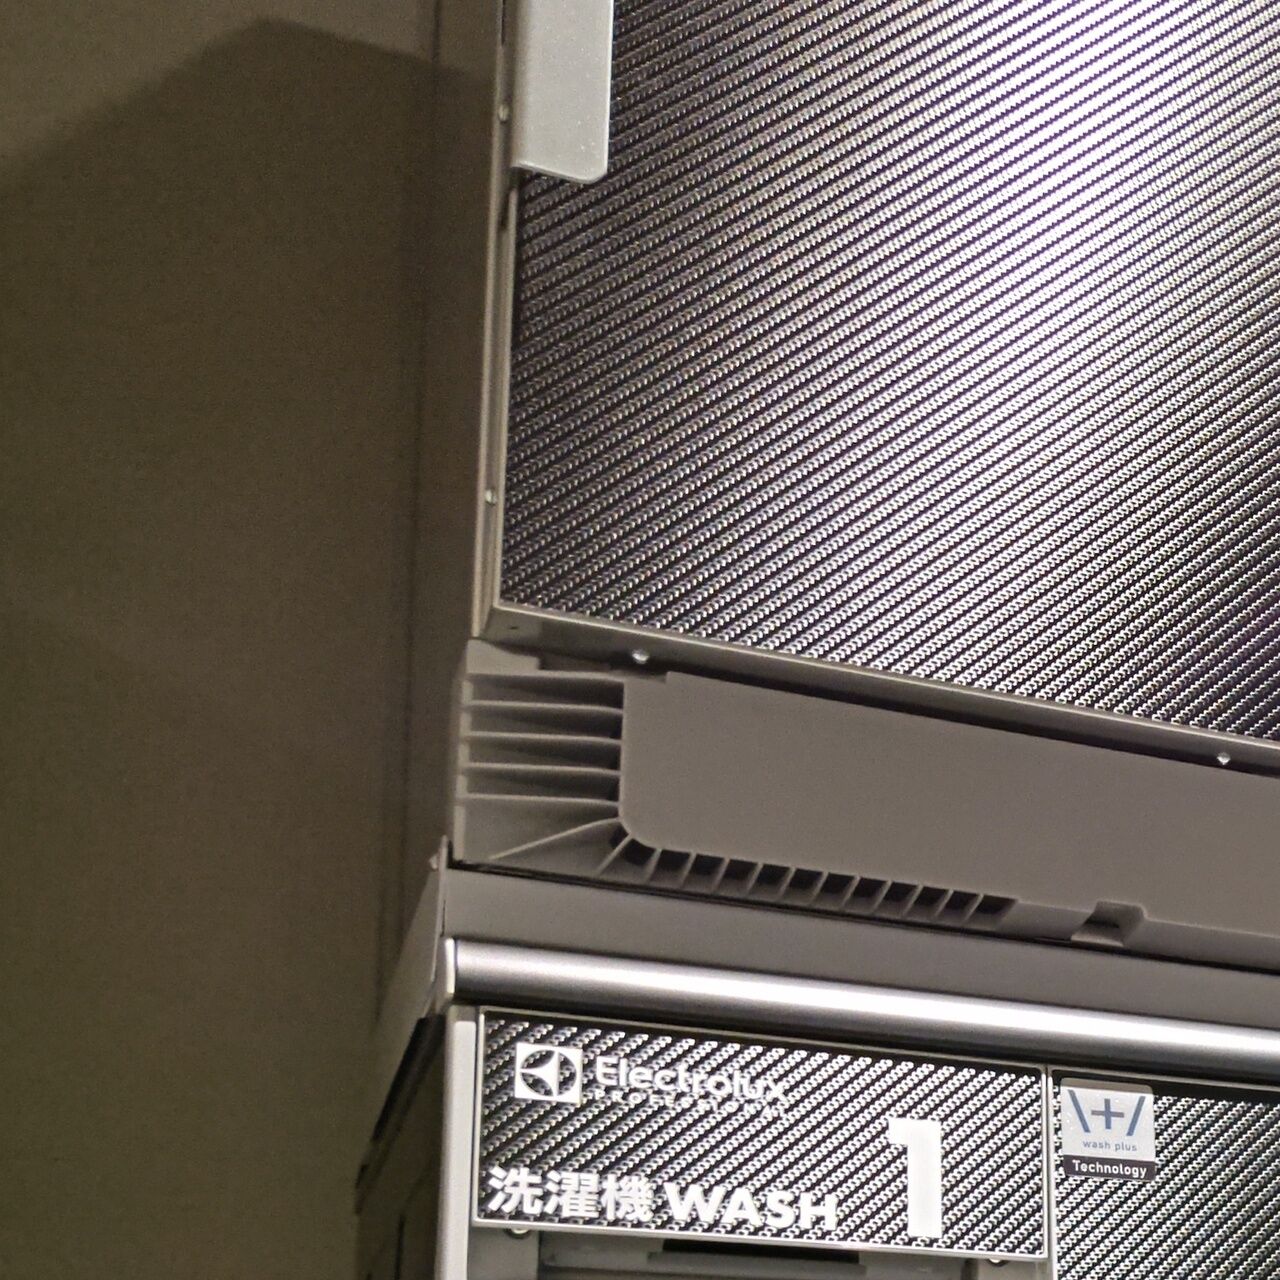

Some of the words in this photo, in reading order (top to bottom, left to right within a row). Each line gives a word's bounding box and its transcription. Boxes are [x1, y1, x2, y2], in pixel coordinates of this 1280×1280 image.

[596, 1055, 786, 1101] Electrolux
[1082, 1139, 1111, 1150] wash
[1115, 1141, 1138, 1152] plus
[488, 1166, 654, 1221] 洗濯機
[664, 1182, 838, 1231] WASH
[888, 1117, 942, 1238] 1
[1072, 1159, 1147, 1178] Technology
